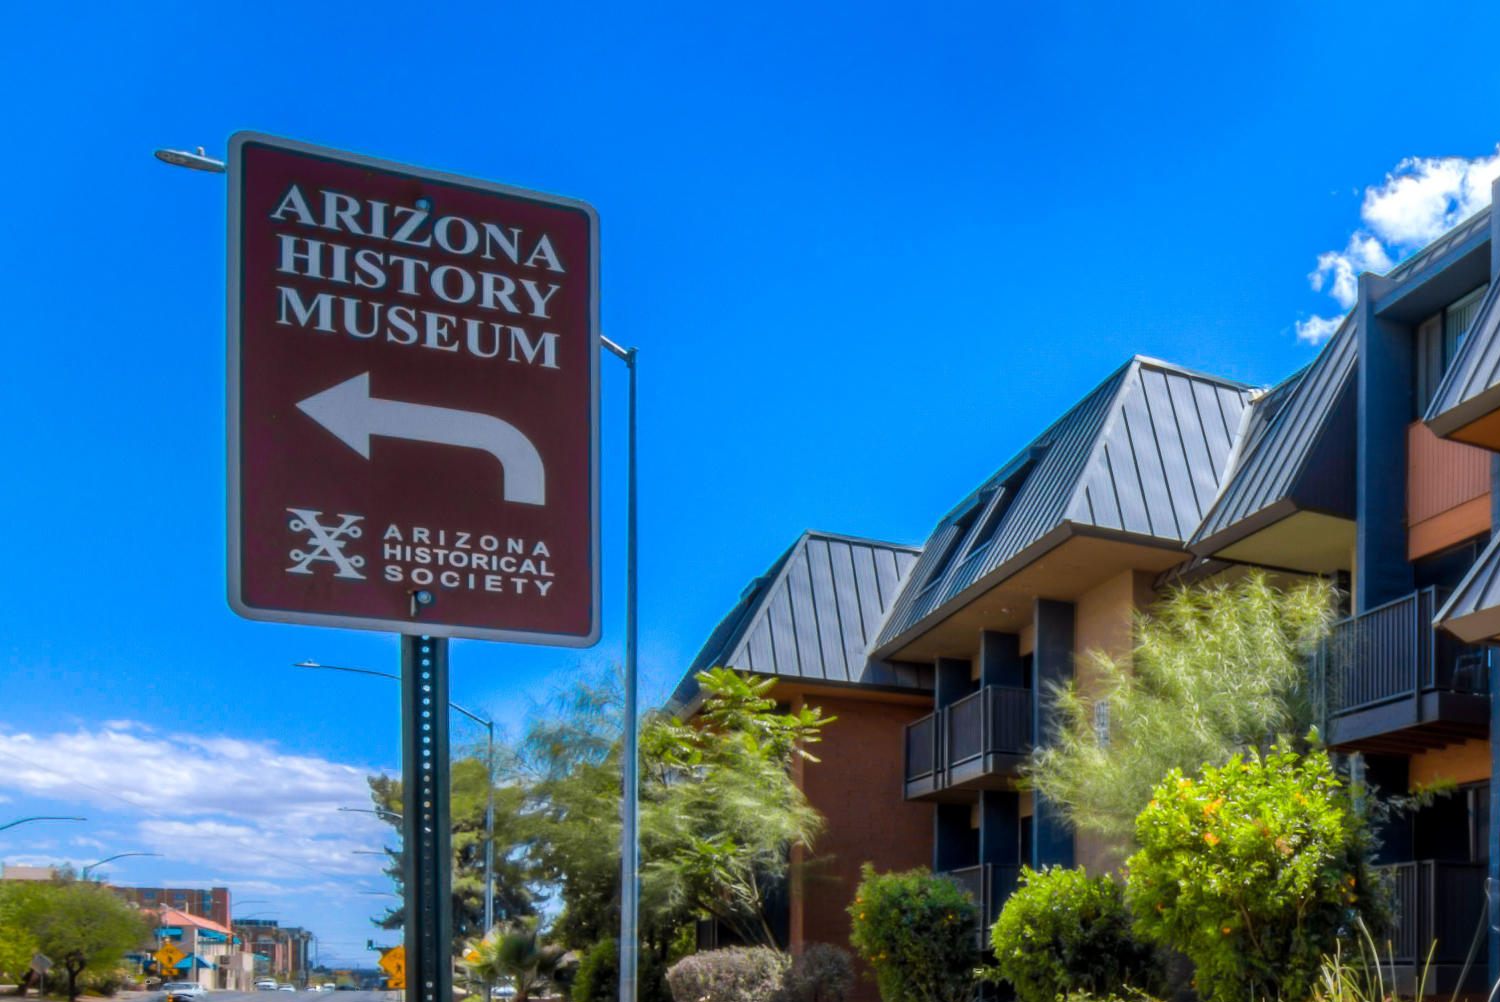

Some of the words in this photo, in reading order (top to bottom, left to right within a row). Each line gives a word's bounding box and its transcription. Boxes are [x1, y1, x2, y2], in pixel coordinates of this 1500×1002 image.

[270, 184, 566, 273] ARIZONA
[276, 233, 561, 319] HISTORY
[276, 286, 561, 369] MUSEUM
[383, 524, 551, 558] ARIZONA
[383, 543, 555, 577] HISTORICAL
[384, 565, 553, 596] SOCIETY
